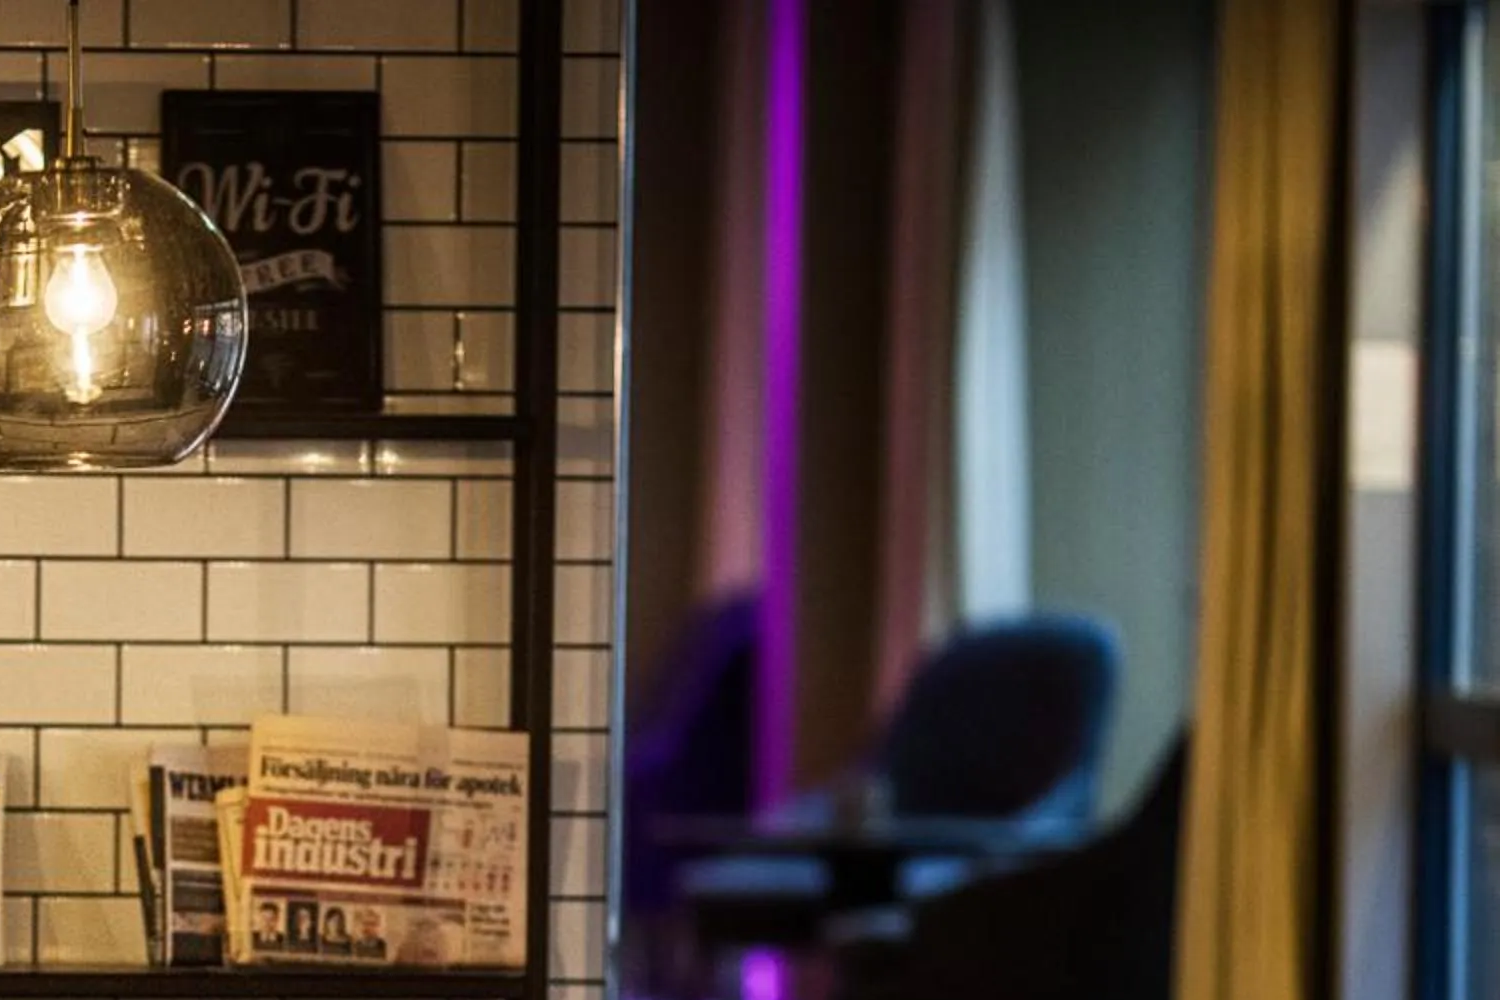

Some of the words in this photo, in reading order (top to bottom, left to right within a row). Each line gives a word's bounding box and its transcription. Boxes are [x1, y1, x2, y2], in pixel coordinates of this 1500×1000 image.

[176, 160, 363, 235] Wi-Fi
[259, 754, 372, 789] Försäljning
[424, 766, 454, 789] för
[456, 774, 522, 797] apotek
[266, 805, 373, 842] Dagens
[252, 825, 418, 880] industri
